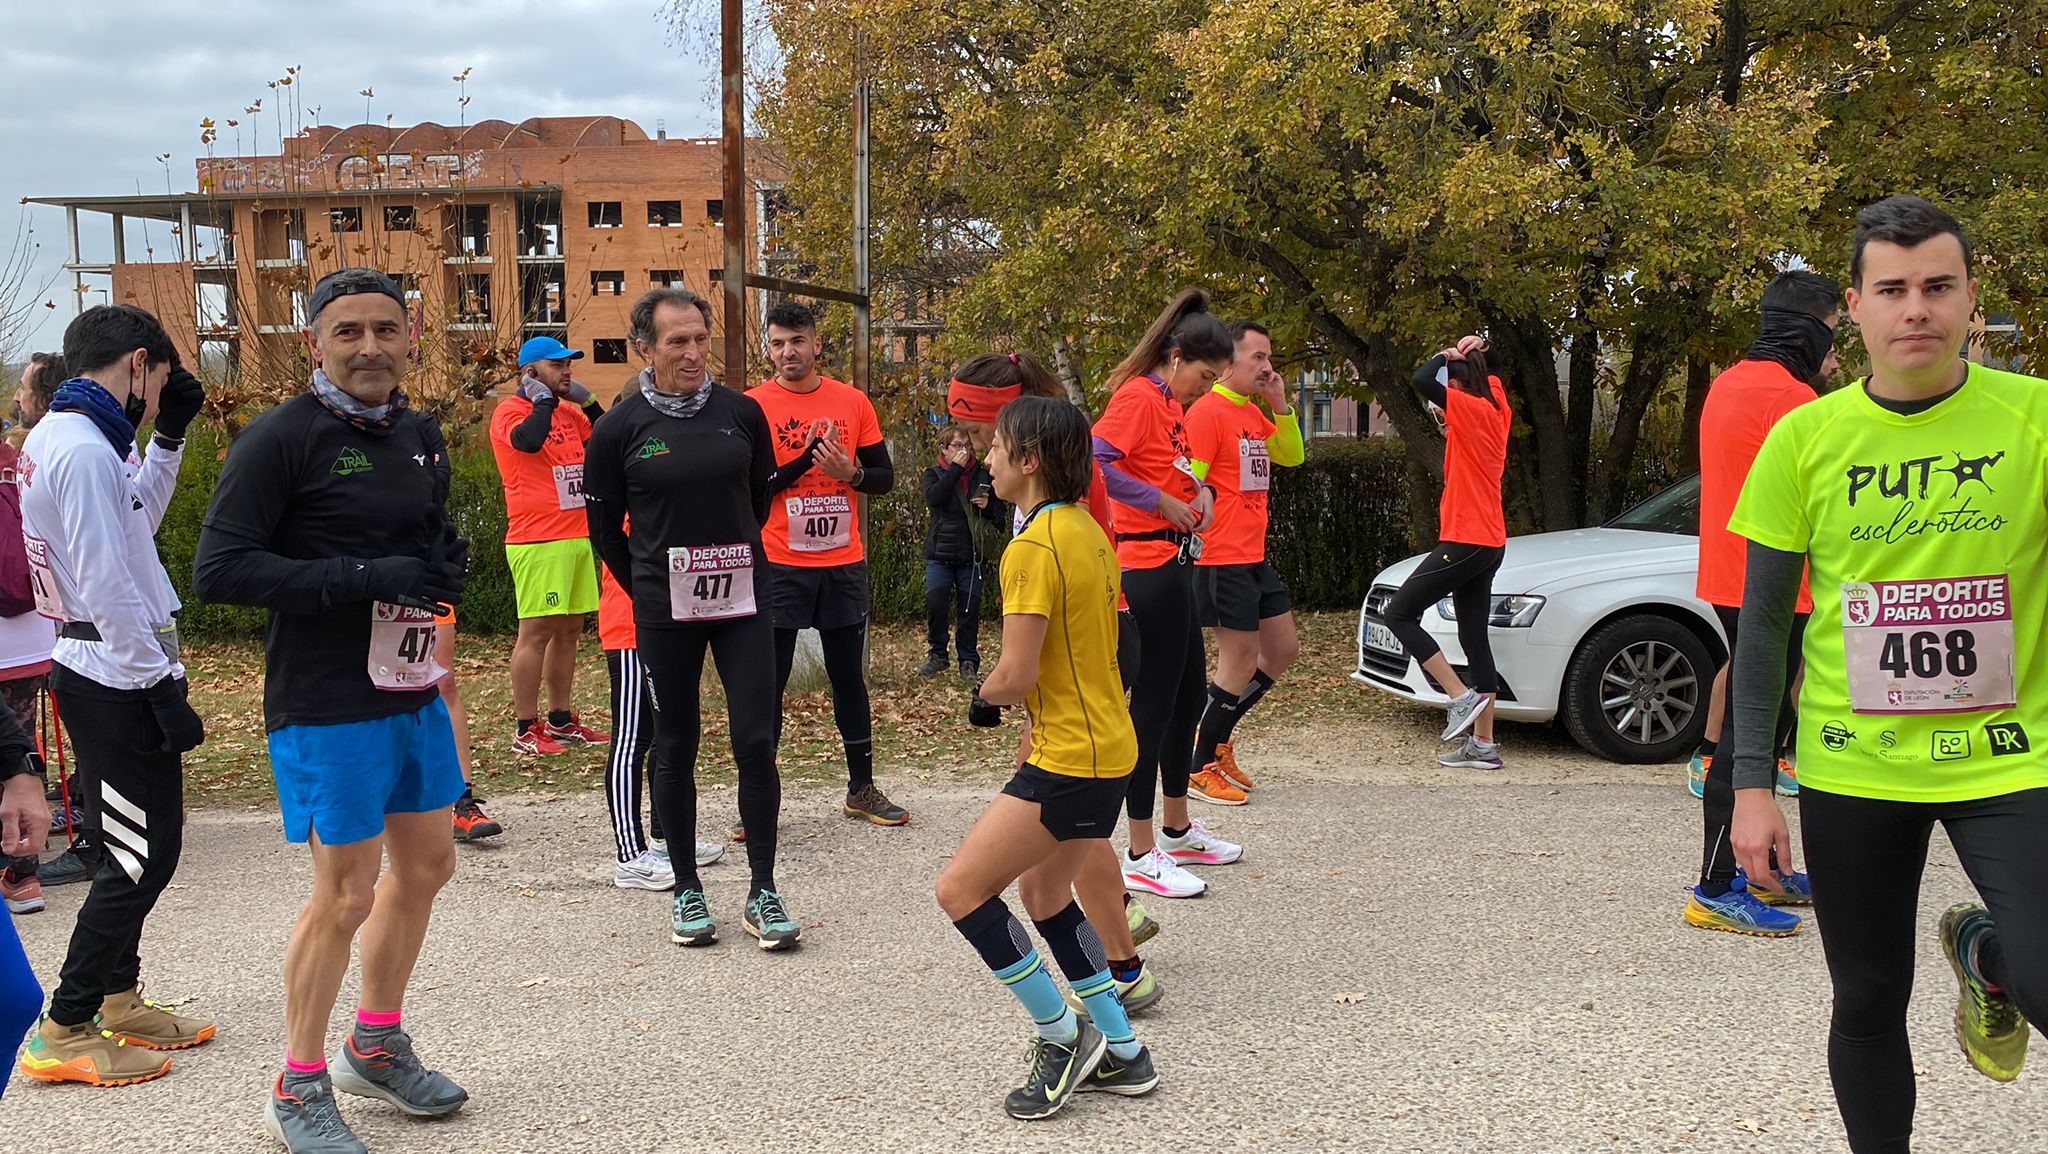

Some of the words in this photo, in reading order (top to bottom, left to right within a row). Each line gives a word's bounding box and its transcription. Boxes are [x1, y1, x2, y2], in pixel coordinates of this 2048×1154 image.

[340, 455, 373, 469] TRAIL
[1251, 459, 1268, 478] 458
[568, 480, 584, 497] 44
[804, 496, 848, 506] DEPORTE
[804, 506, 824, 514] PARA
[805, 516, 839, 538] 407
[692, 545, 751, 561] DEPORTE
[692, 561, 718, 570] PARA
[720, 557, 752, 568] TODOS
[693, 573, 733, 601] 477
[1882, 578, 2004, 605] DEPORTE
[1883, 606, 1932, 622] PARA
[1937, 601, 2005, 620] TODOS
[1879, 629, 1978, 679] 468
